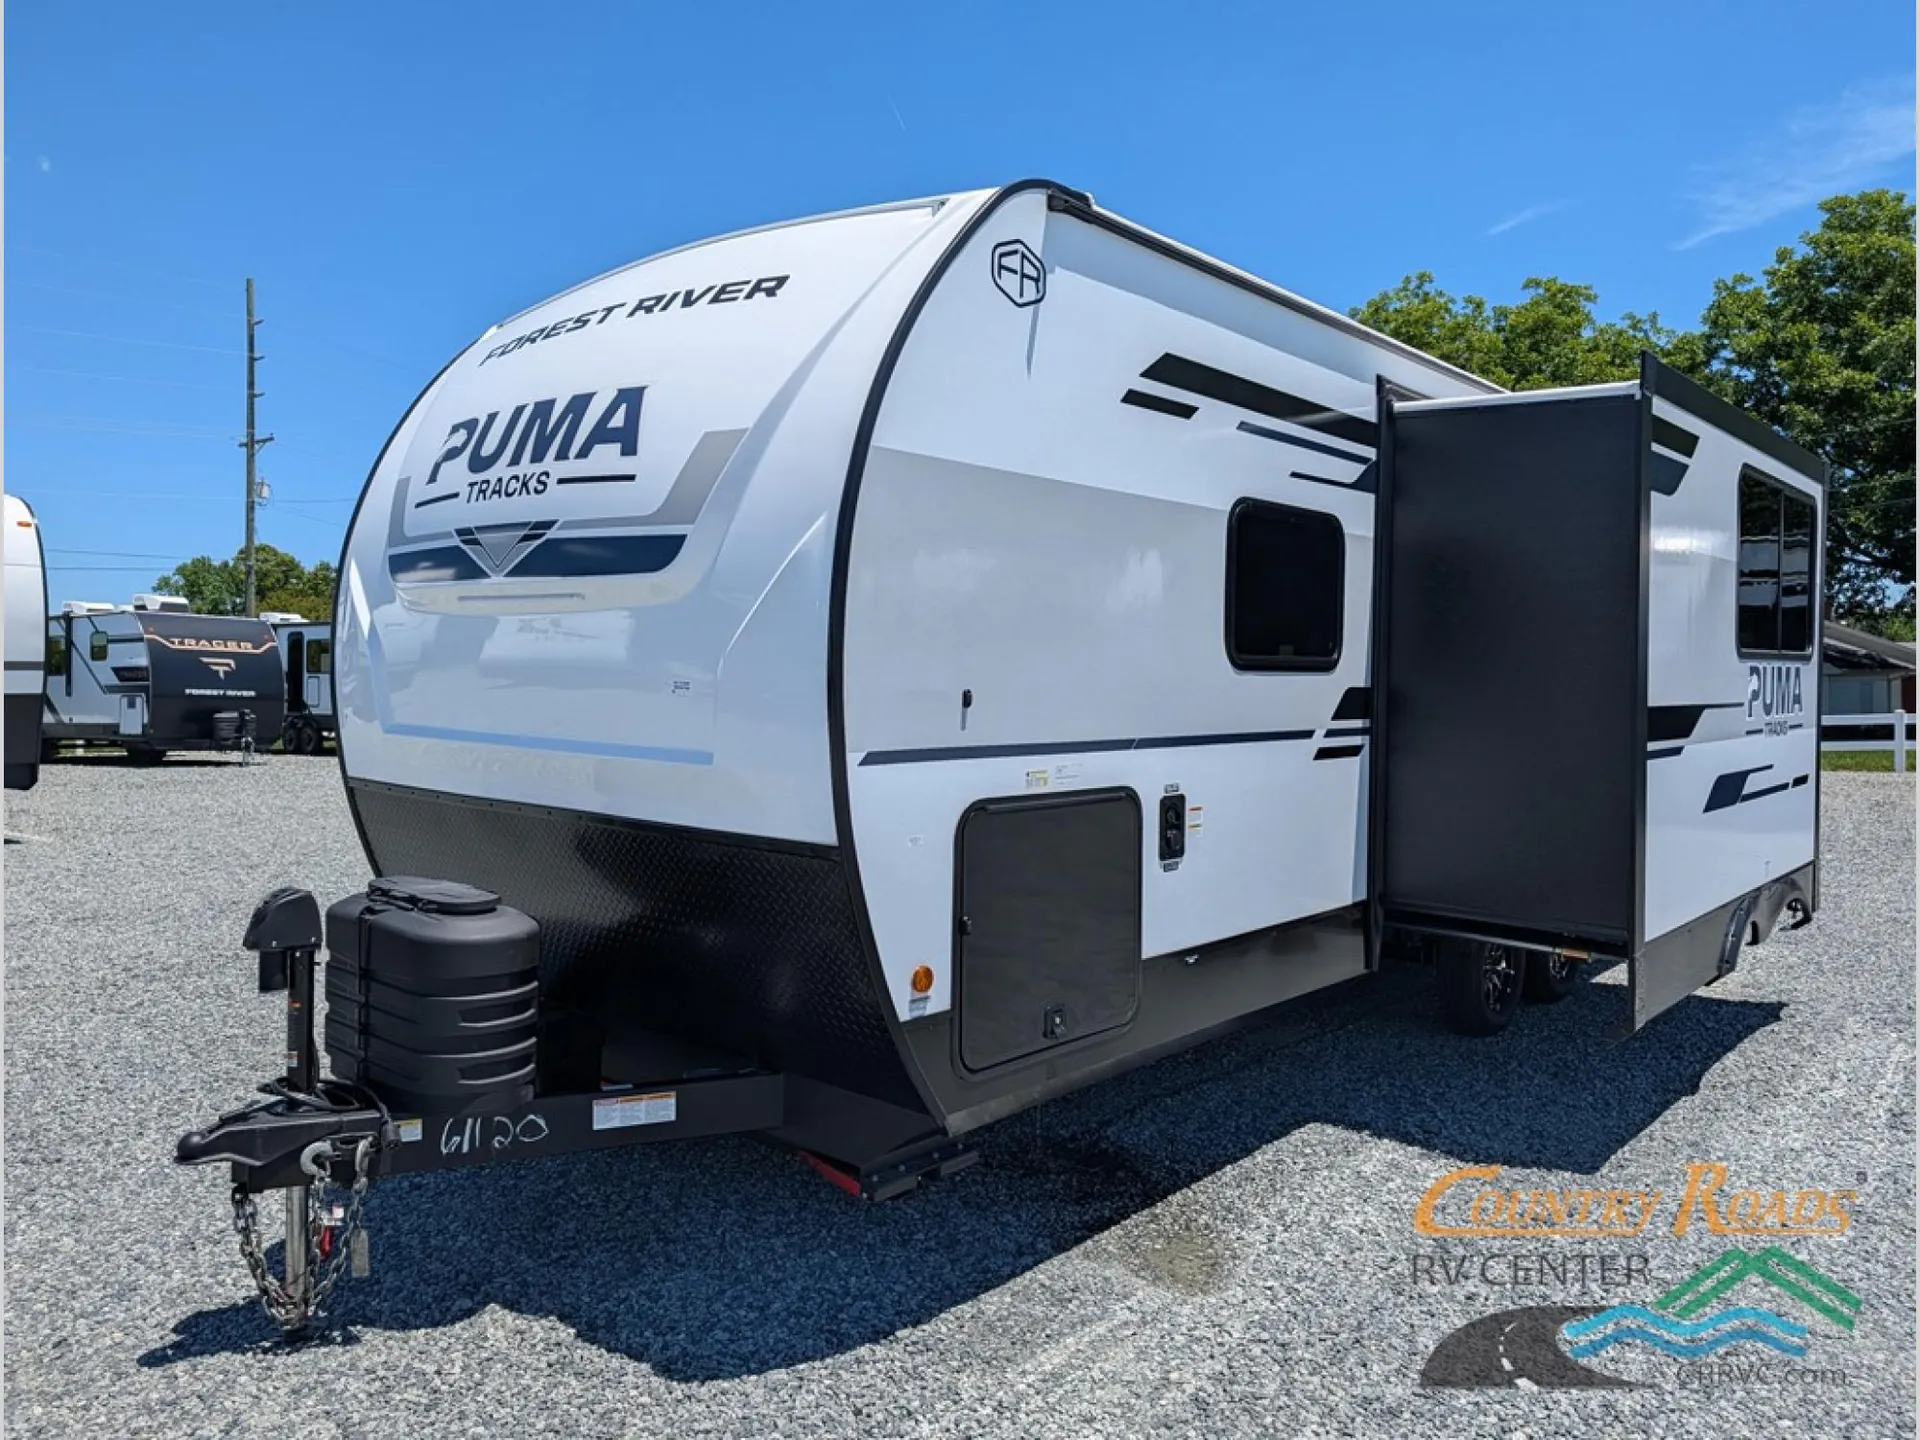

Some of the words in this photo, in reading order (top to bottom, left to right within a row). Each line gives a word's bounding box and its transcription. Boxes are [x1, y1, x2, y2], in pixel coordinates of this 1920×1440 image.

[478, 302, 627, 367] FOREST
[626, 274, 791, 318] RIVER
[425, 385, 649, 485] PUMA
[466, 470, 551, 503] TRACKS
[169, 638, 253, 650] TRACER
[184, 688, 225, 697] FOREST
[225, 689, 257, 698] RIVER
[1747, 666, 1804, 717] PUMA
